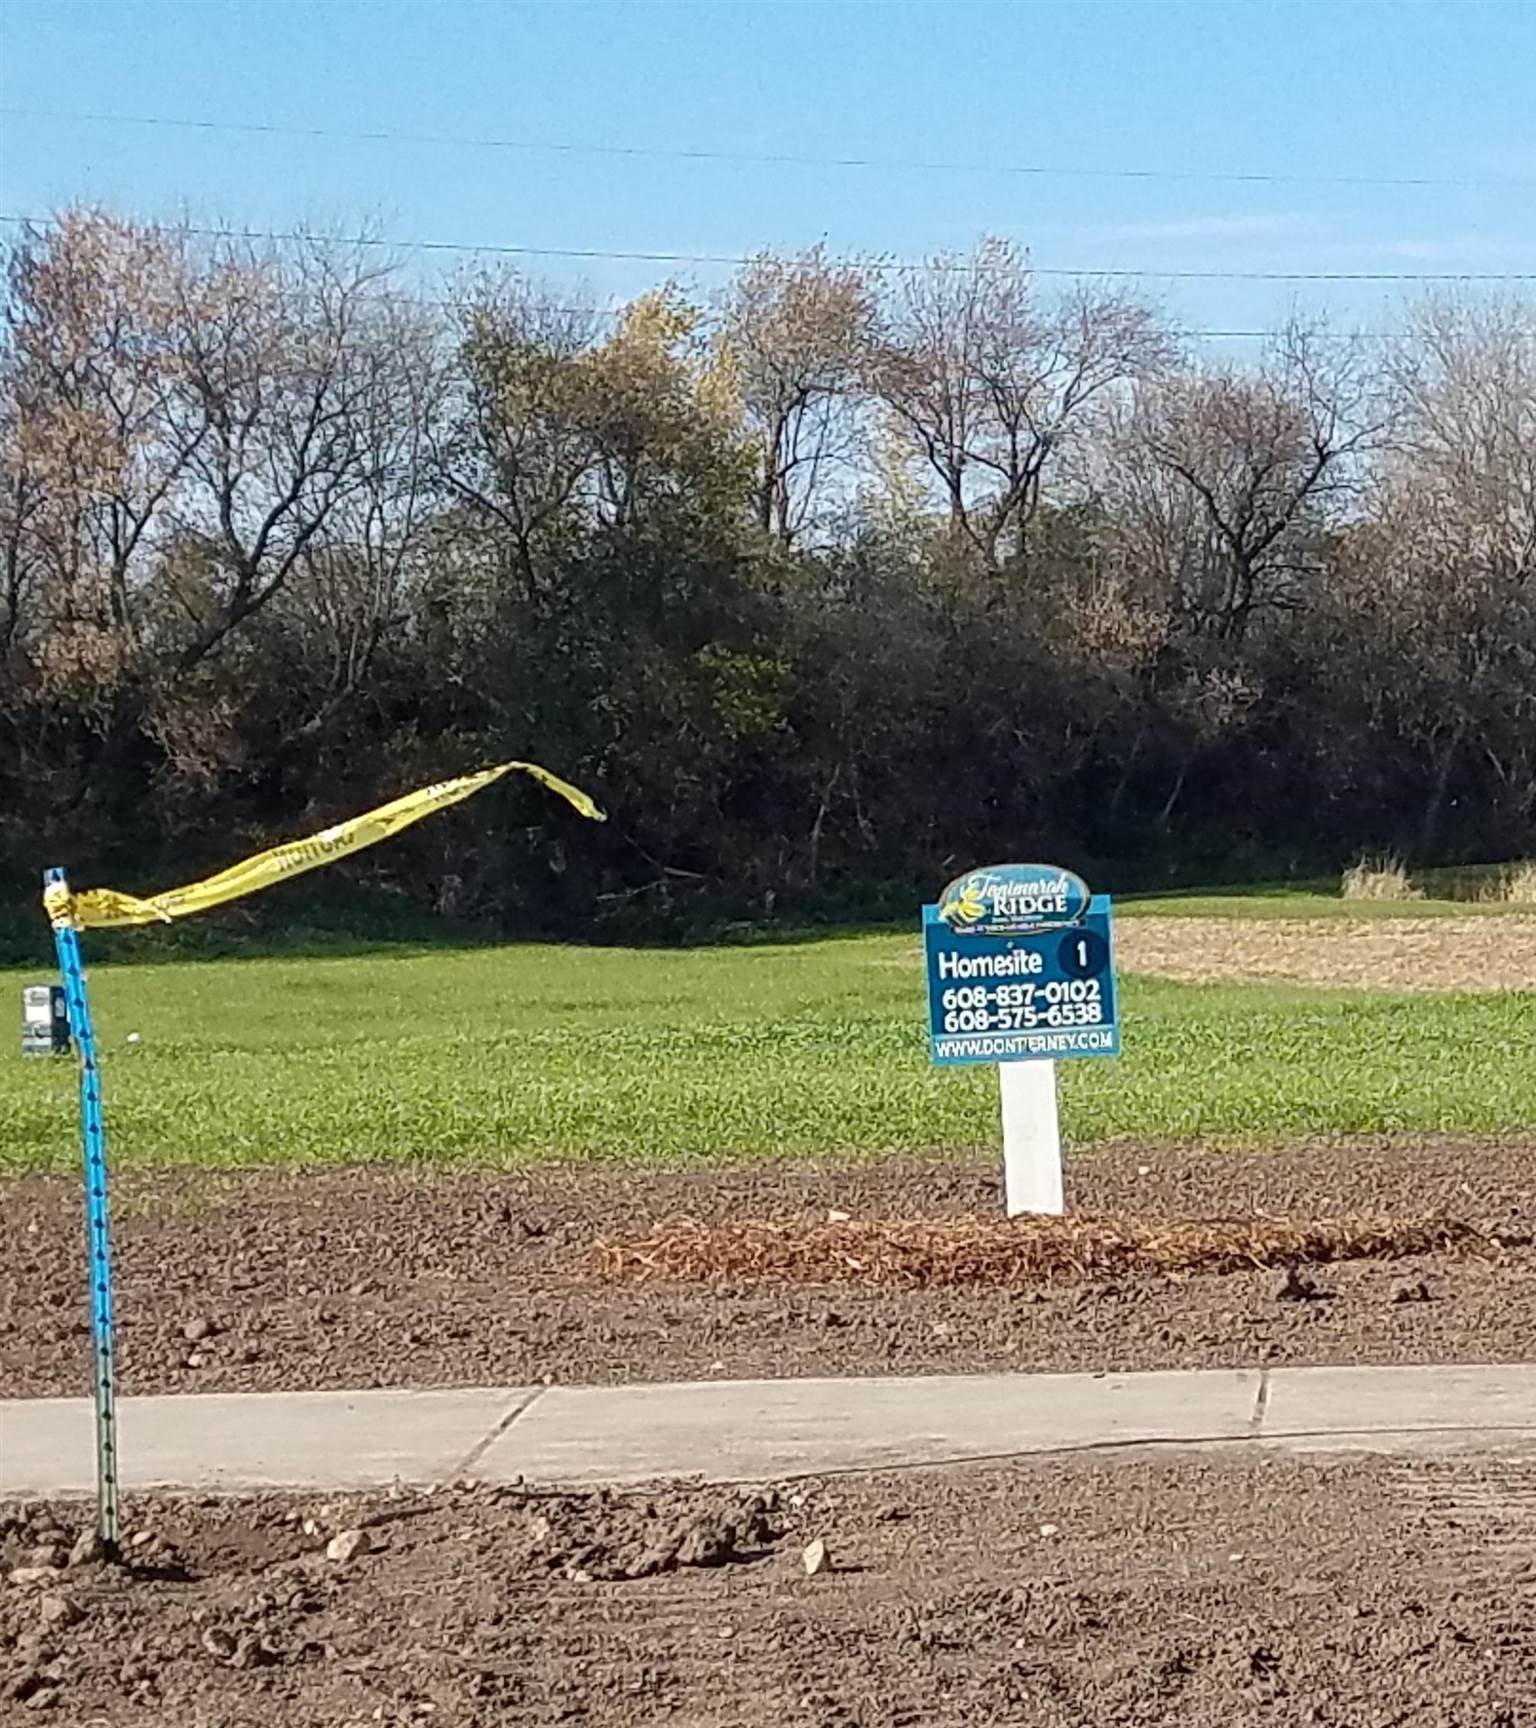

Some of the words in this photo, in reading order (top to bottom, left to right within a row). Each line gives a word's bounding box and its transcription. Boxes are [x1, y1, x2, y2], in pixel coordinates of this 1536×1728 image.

[992, 896, 1068, 917] RIDGE
[938, 949, 1043, 980] Homesite
[1076, 940, 1087, 967] 1
[942, 979, 1102, 1010] 608-837-0102
[944, 1003, 1102, 1032] 608-575-6538
